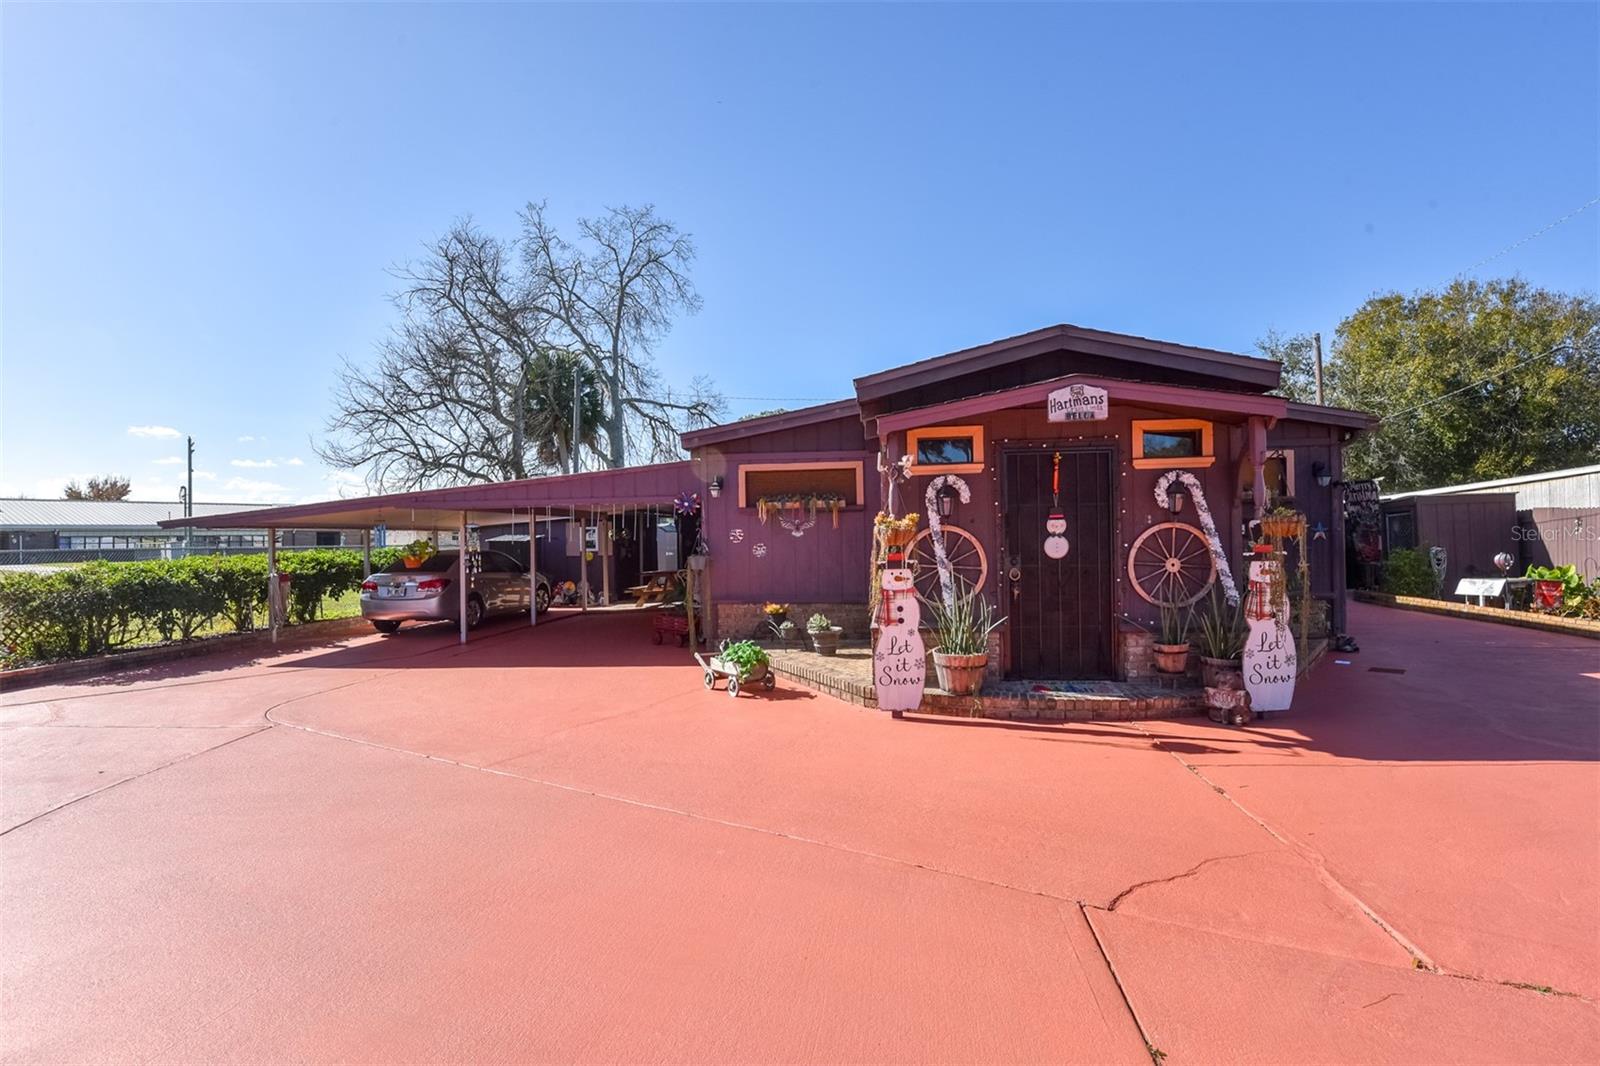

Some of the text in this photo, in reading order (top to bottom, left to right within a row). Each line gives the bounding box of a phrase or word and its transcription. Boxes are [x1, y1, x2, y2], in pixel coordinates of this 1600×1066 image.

[1050, 395, 1104, 413] Hartmans
[887, 635, 913, 656] Let
[1256, 631, 1284, 653] Let
[895, 657, 912, 672] it
[1266, 655, 1283, 670] it
[878, 665, 922, 687] Snow
[1249, 662, 1294, 685] Snow
